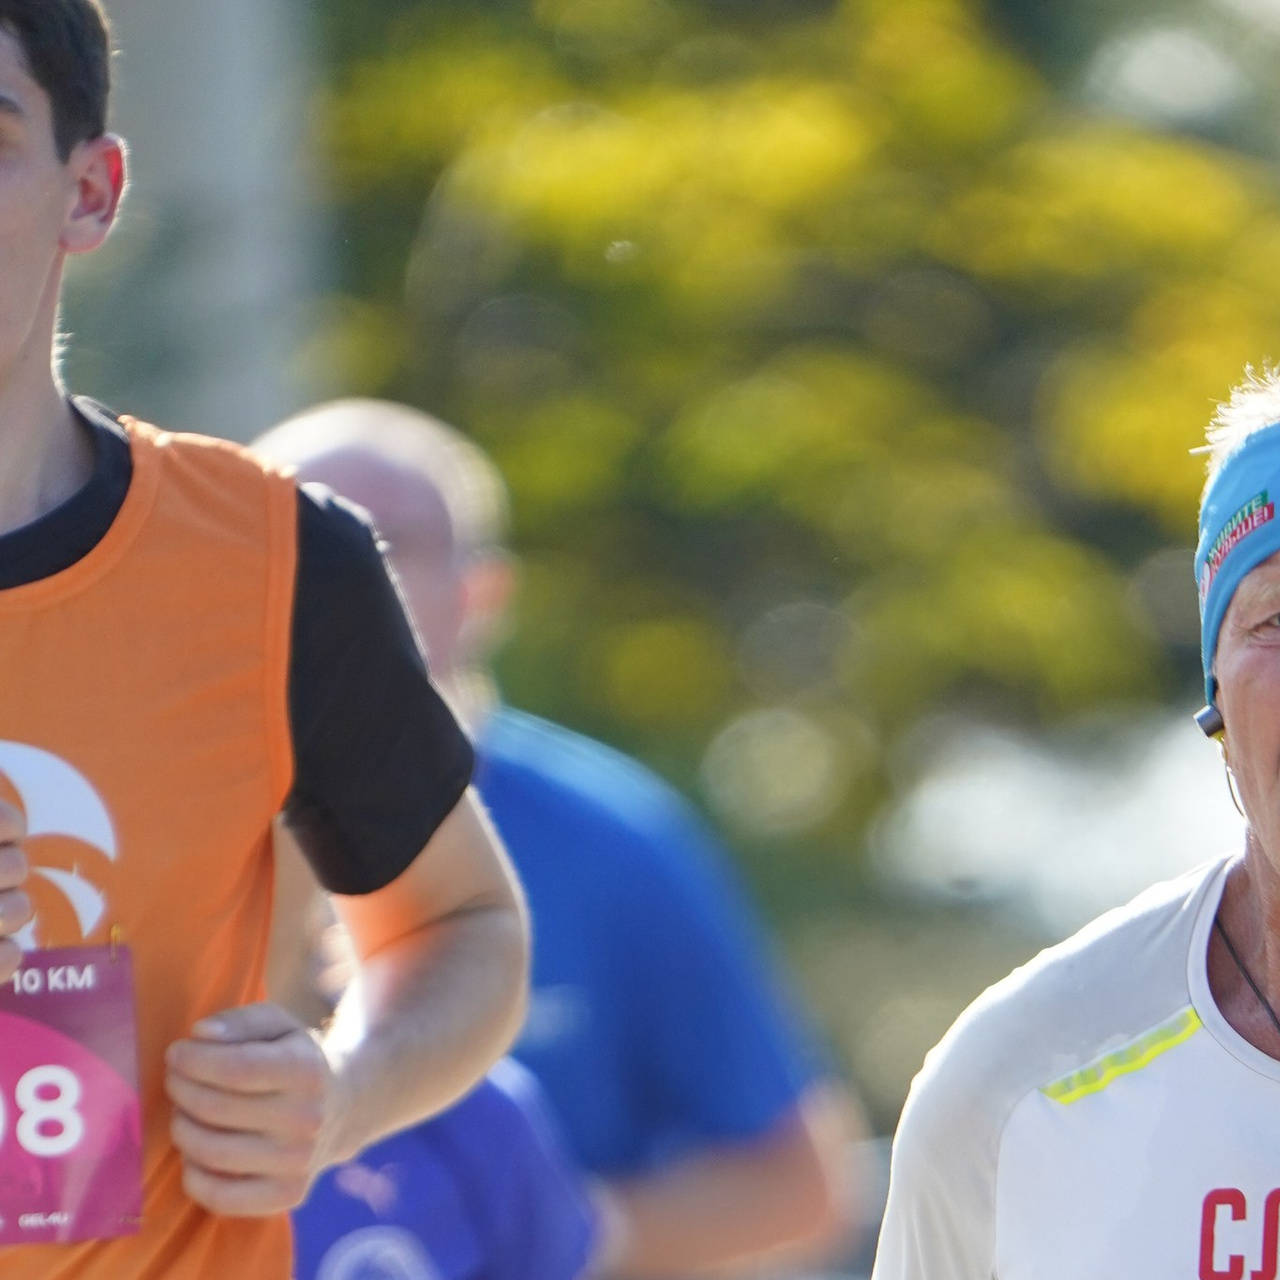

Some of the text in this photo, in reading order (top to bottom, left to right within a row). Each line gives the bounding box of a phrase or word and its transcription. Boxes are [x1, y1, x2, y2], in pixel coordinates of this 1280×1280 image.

[12, 964, 96, 995] 10 KM
[0, 1064, 84, 1157] 8
